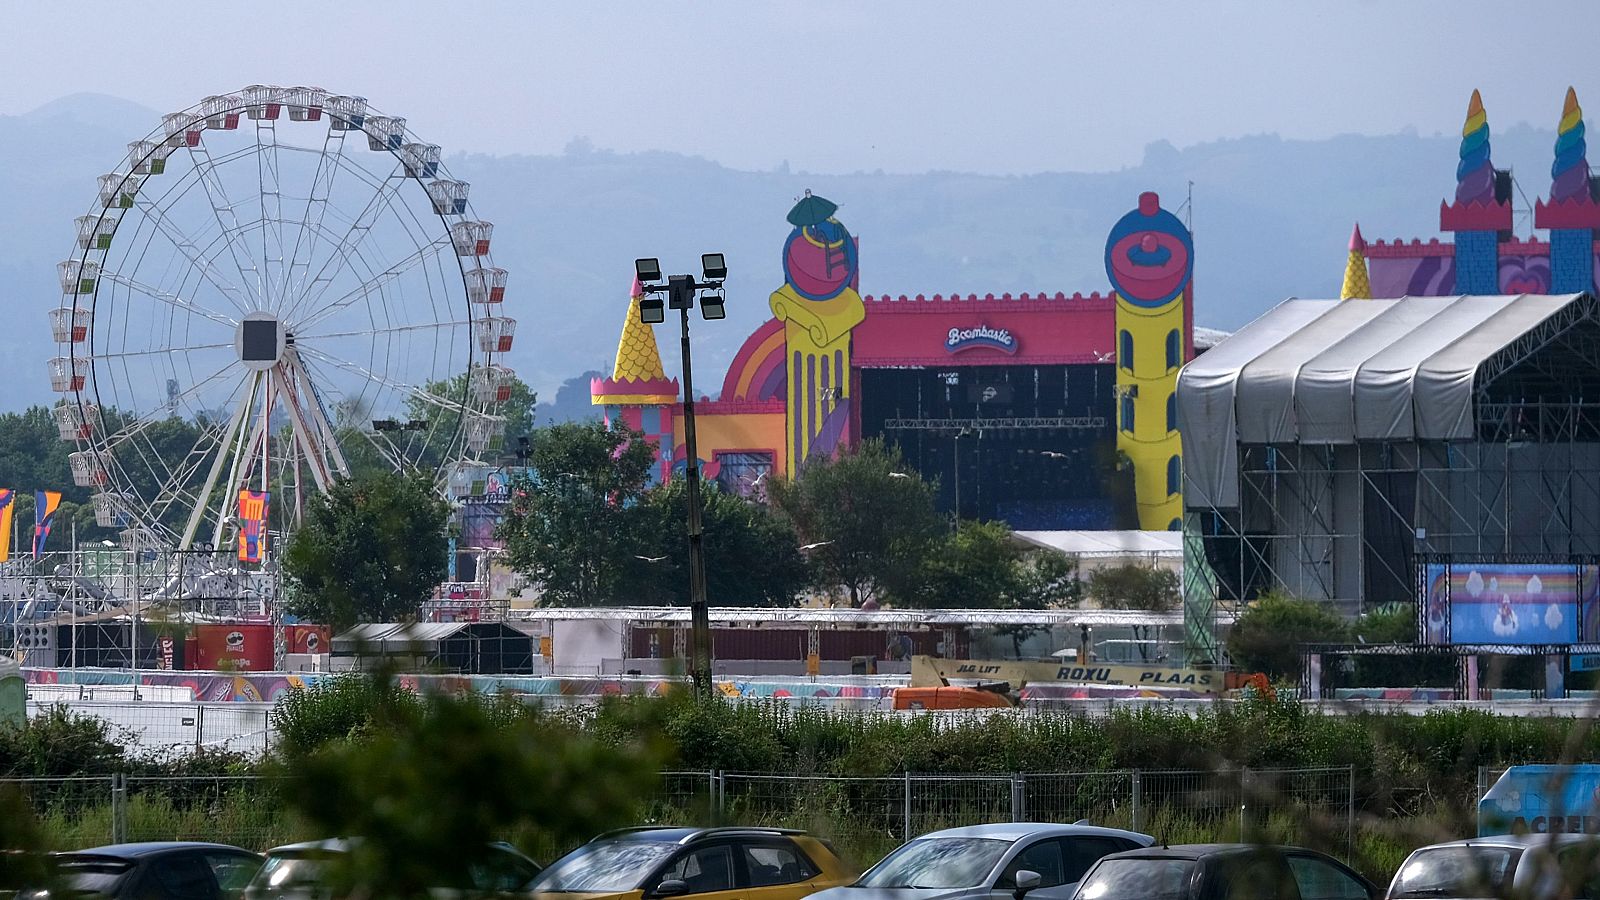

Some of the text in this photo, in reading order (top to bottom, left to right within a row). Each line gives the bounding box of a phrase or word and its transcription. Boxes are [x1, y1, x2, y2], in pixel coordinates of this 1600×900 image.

[948, 325, 1012, 345] Boombastic
[956, 664, 1001, 674] JLG LIFT
[1056, 667, 1112, 681] ROXU
[1139, 672, 1213, 685] PLAAS
